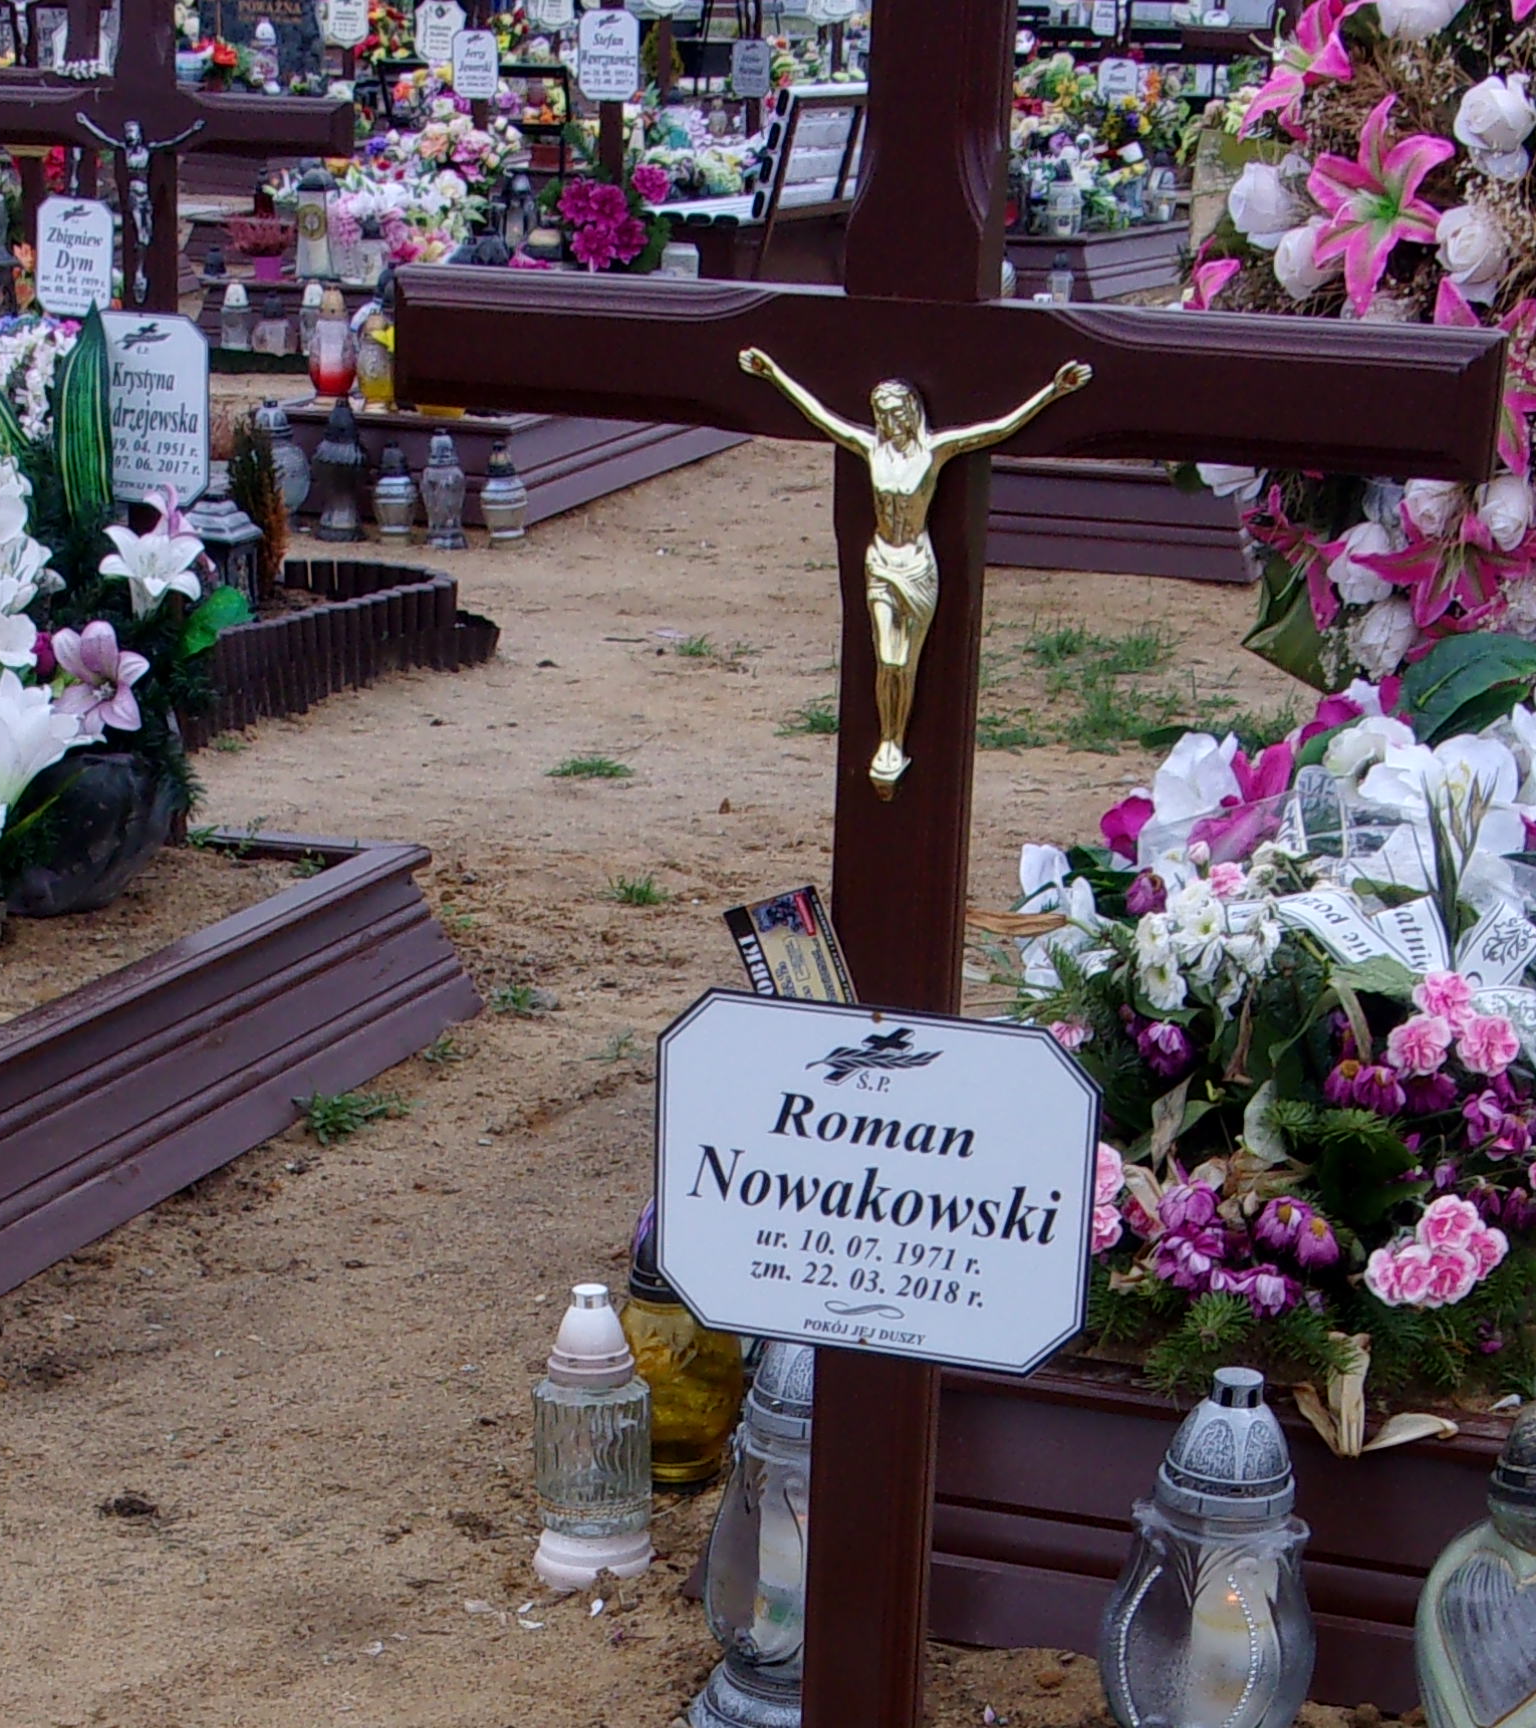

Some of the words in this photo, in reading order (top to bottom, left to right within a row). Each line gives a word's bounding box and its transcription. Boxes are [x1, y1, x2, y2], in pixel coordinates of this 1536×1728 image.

[47, 226, 104, 249] Zbigniew
[55, 250, 95, 275] Dym
[113, 362, 175, 396] Krystyna
[113, 397, 199, 438] drzejewska
[135, 457, 153, 472] 06.
[157, 459, 189, 474] 2017
[156, 441, 186, 456] 1951
[738, 933, 776, 996] OBKI
[768, 1091, 976, 1158] Roman
[686, 1144, 1062, 1245] Nowakowski
[756, 1229, 788, 1250] ur.
[799, 1229, 835, 1256] 10.
[846, 1235, 882, 1262] 07.
[893, 1241, 957, 1271] 1971
[964, 1257, 982, 1275] r.
[750, 1259, 792, 1281] zm.
[801, 1262, 838, 1288] 22.
[849, 1269, 885, 1294] 03.
[895, 1274, 959, 1304] 2018
[967, 1289, 984, 1308] r.
[803, 1314, 849, 1336] POKÓJ
[850, 1322, 878, 1340] JEJ
[878, 1326, 926, 1346] DUSZY
